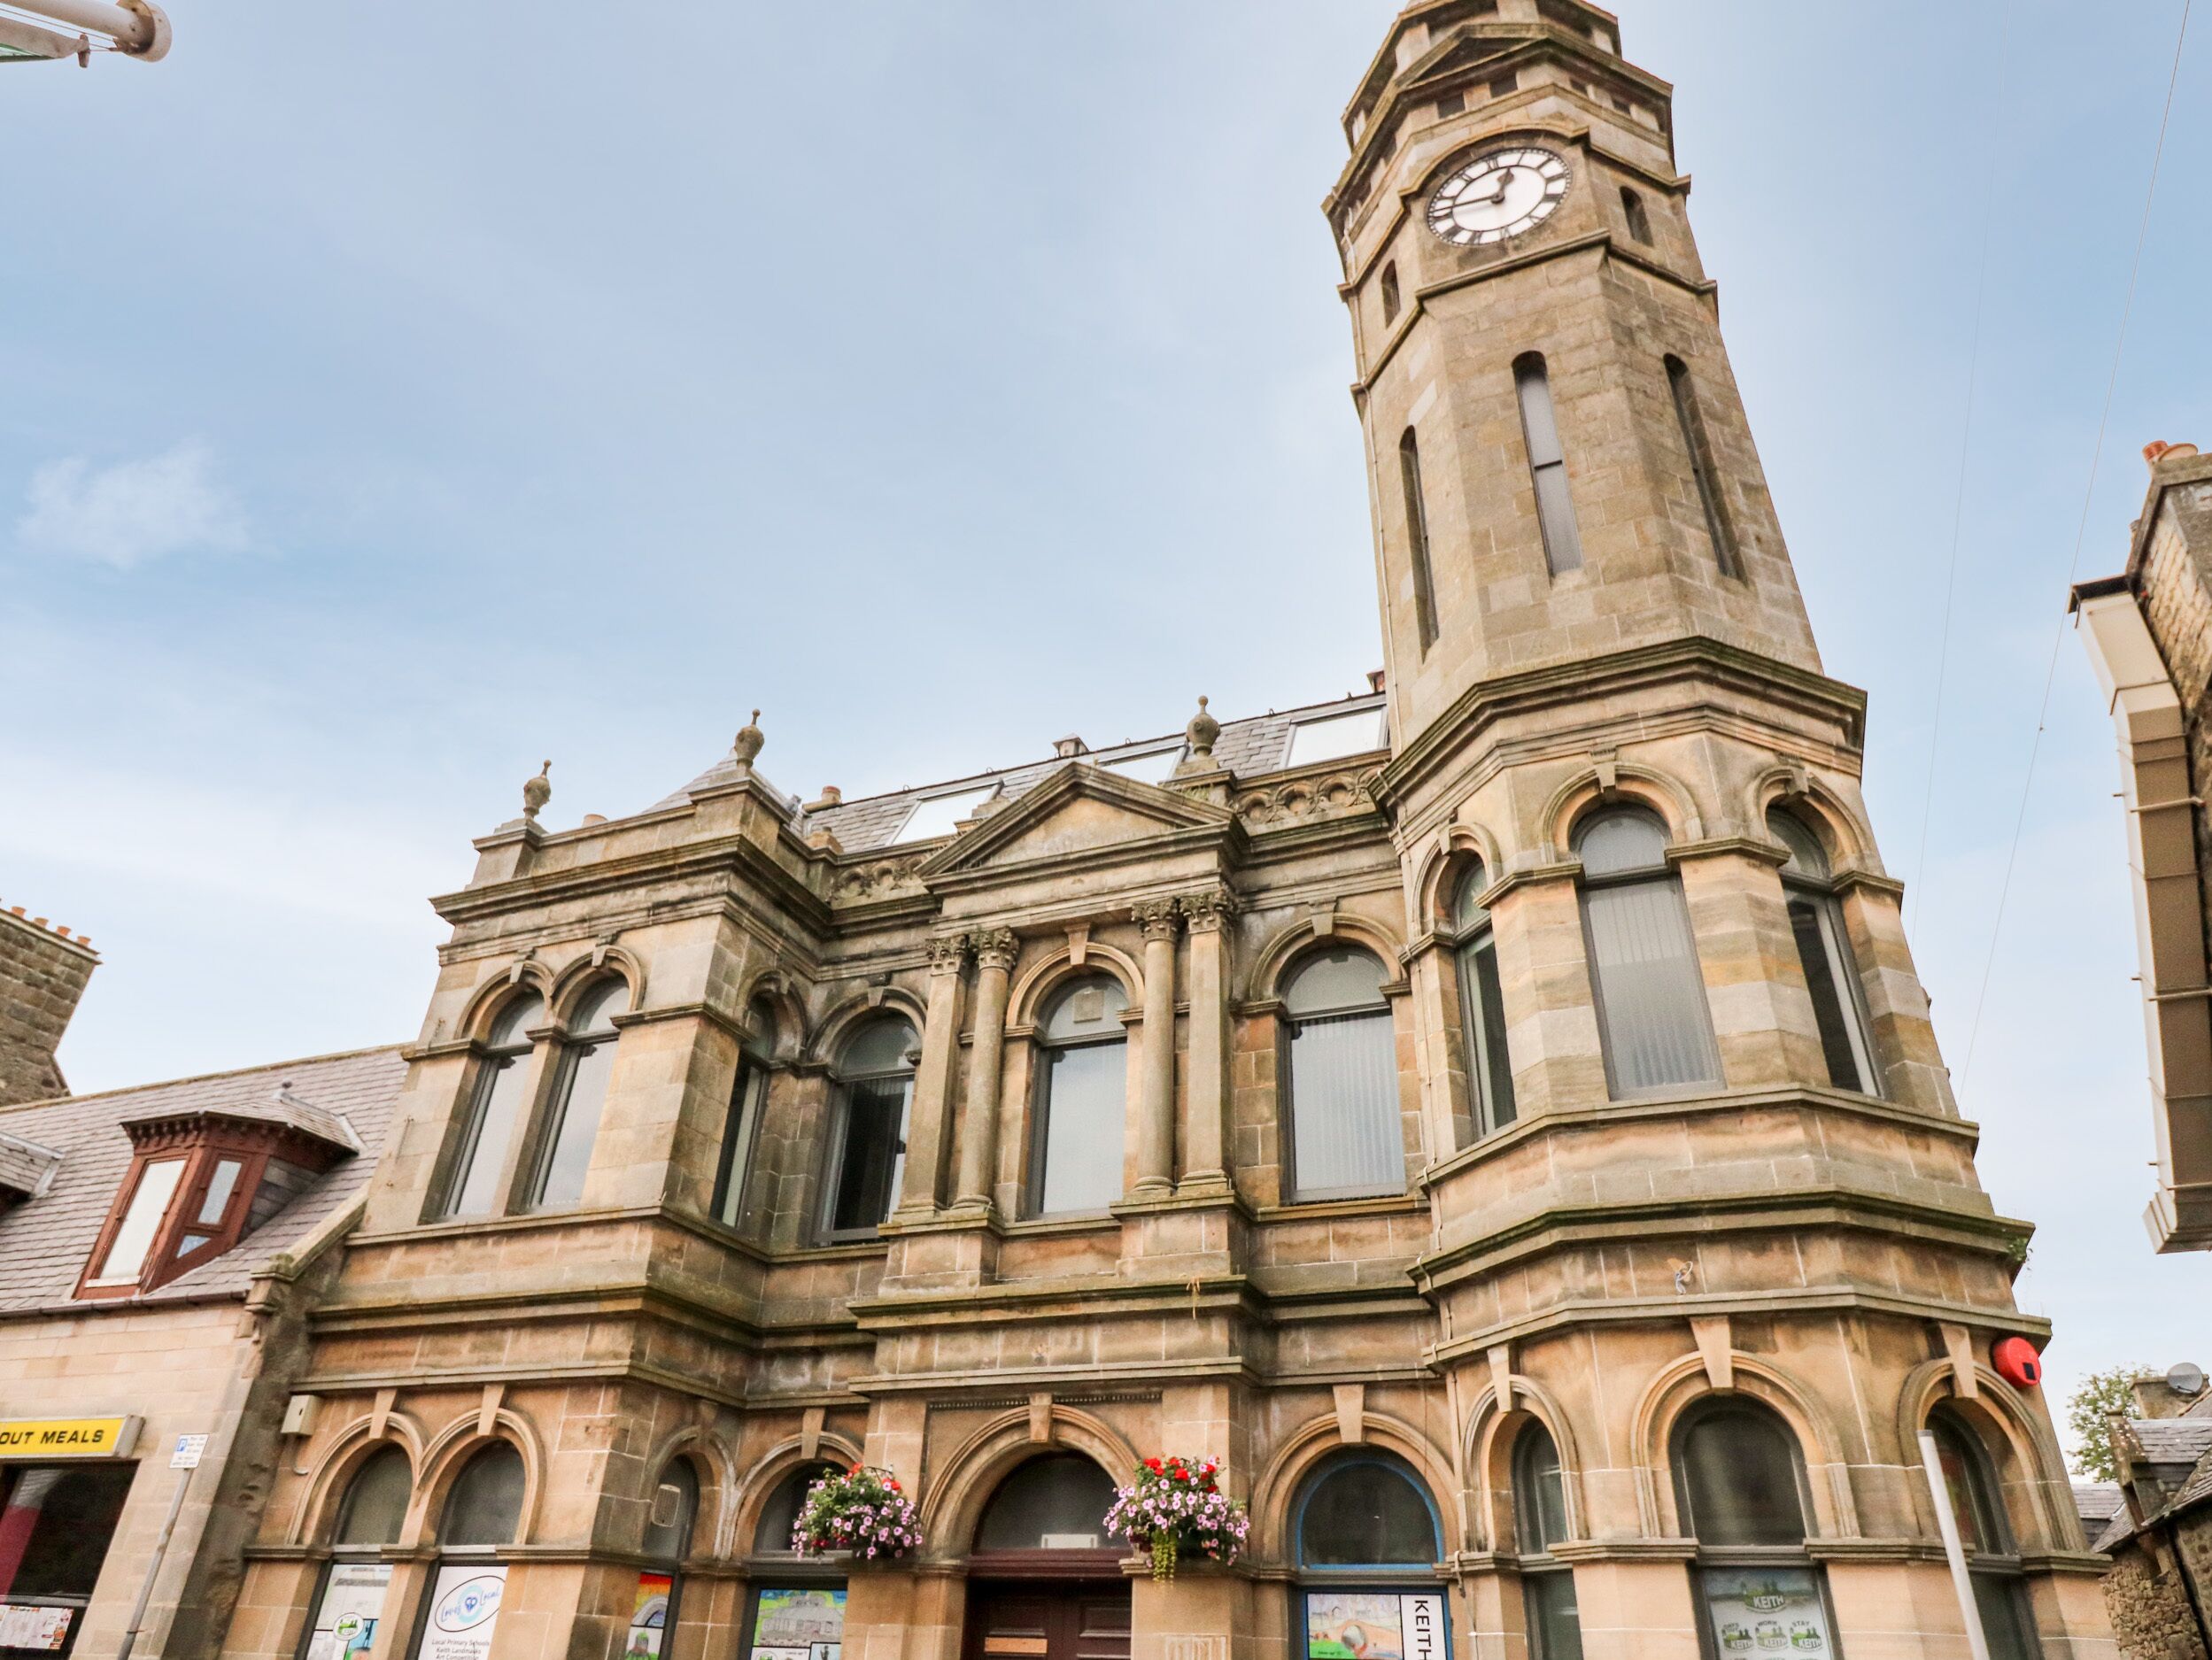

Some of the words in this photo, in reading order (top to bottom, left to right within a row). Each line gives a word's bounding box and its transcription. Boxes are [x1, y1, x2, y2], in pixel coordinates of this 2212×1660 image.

[0, 1431, 35, 1445] OUT
[40, 1429, 104, 1444] MEALS
[1753, 1595, 1785, 1609] KEITH
[1414, 1600, 1432, 1660] KEITH
